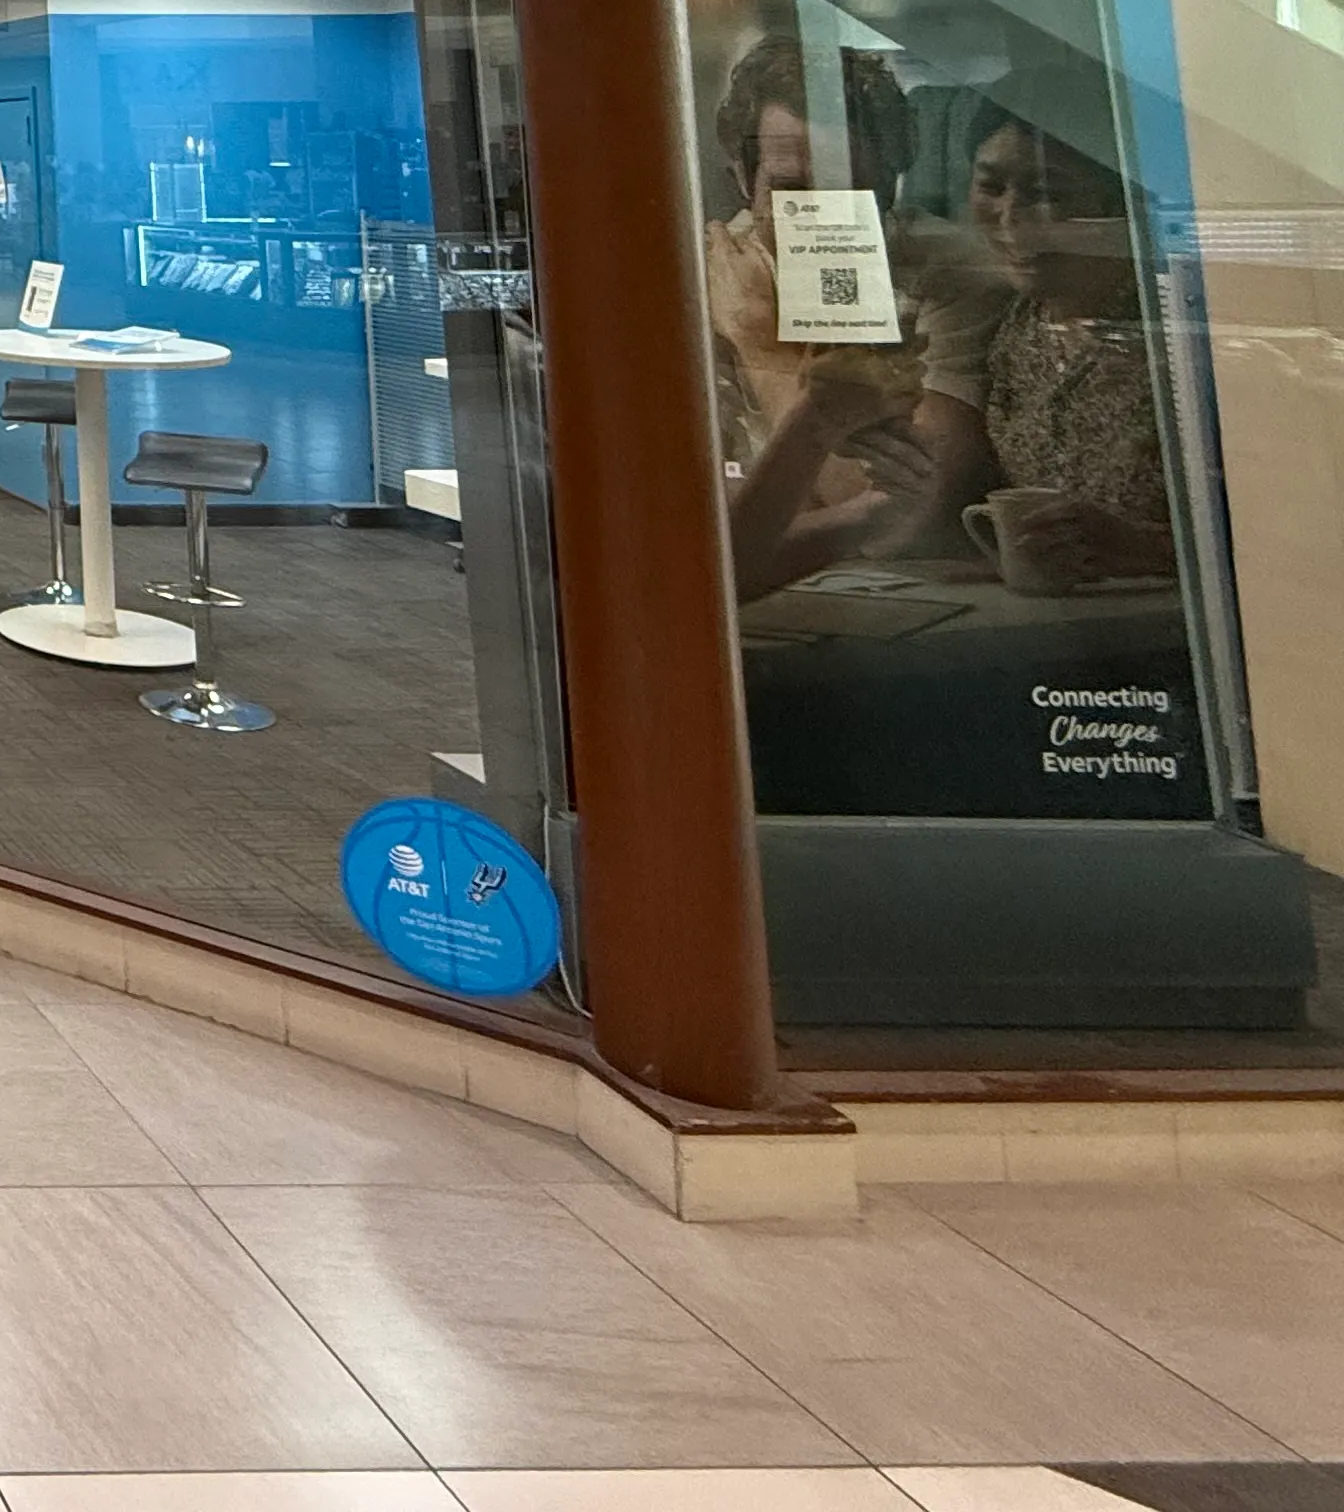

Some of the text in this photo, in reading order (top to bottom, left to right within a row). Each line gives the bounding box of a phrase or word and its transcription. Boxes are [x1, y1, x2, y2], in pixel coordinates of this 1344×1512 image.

[1031, 686, 1170, 713] Connecting
[1048, 715, 1162, 748] Changes
[1041, 751, 1178, 780] Everything
[387, 876, 430, 898] AT&T
